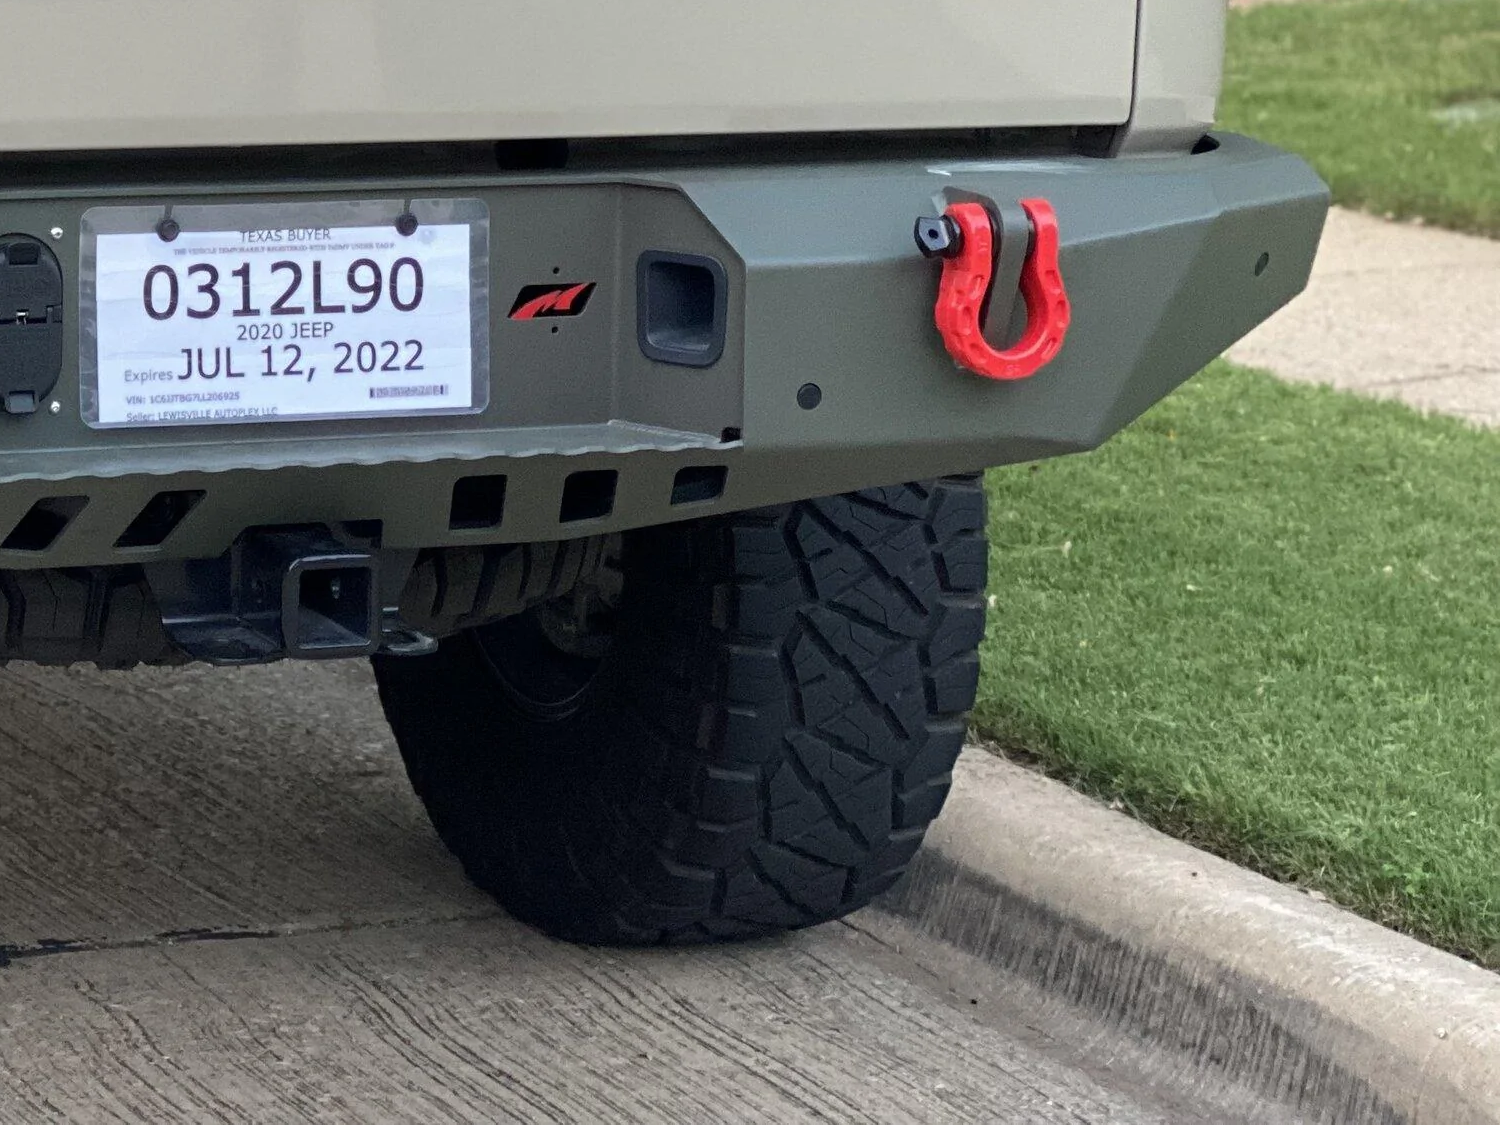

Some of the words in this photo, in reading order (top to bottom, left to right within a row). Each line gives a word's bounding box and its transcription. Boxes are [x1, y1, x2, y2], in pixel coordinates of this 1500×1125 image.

[240, 230, 282, 243] TEXAS
[288, 228, 331, 241] BUYER
[143, 257, 424, 321] 0312L90
[236, 323, 283, 341] 2020
[290, 321, 334, 339] JEEP
[124, 369, 174, 385] Expires
[177, 347, 245, 381] JUL
[261, 344, 315, 383] 12,
[333, 339, 424, 374] 2022
[126, 394, 146, 405] VIN:
[126, 412, 155, 422] Seller:
[158, 409, 211, 420] LEWISVILLE
[214, 408, 259, 419] AUTOPLEX
[262, 406, 278, 415] LLC
